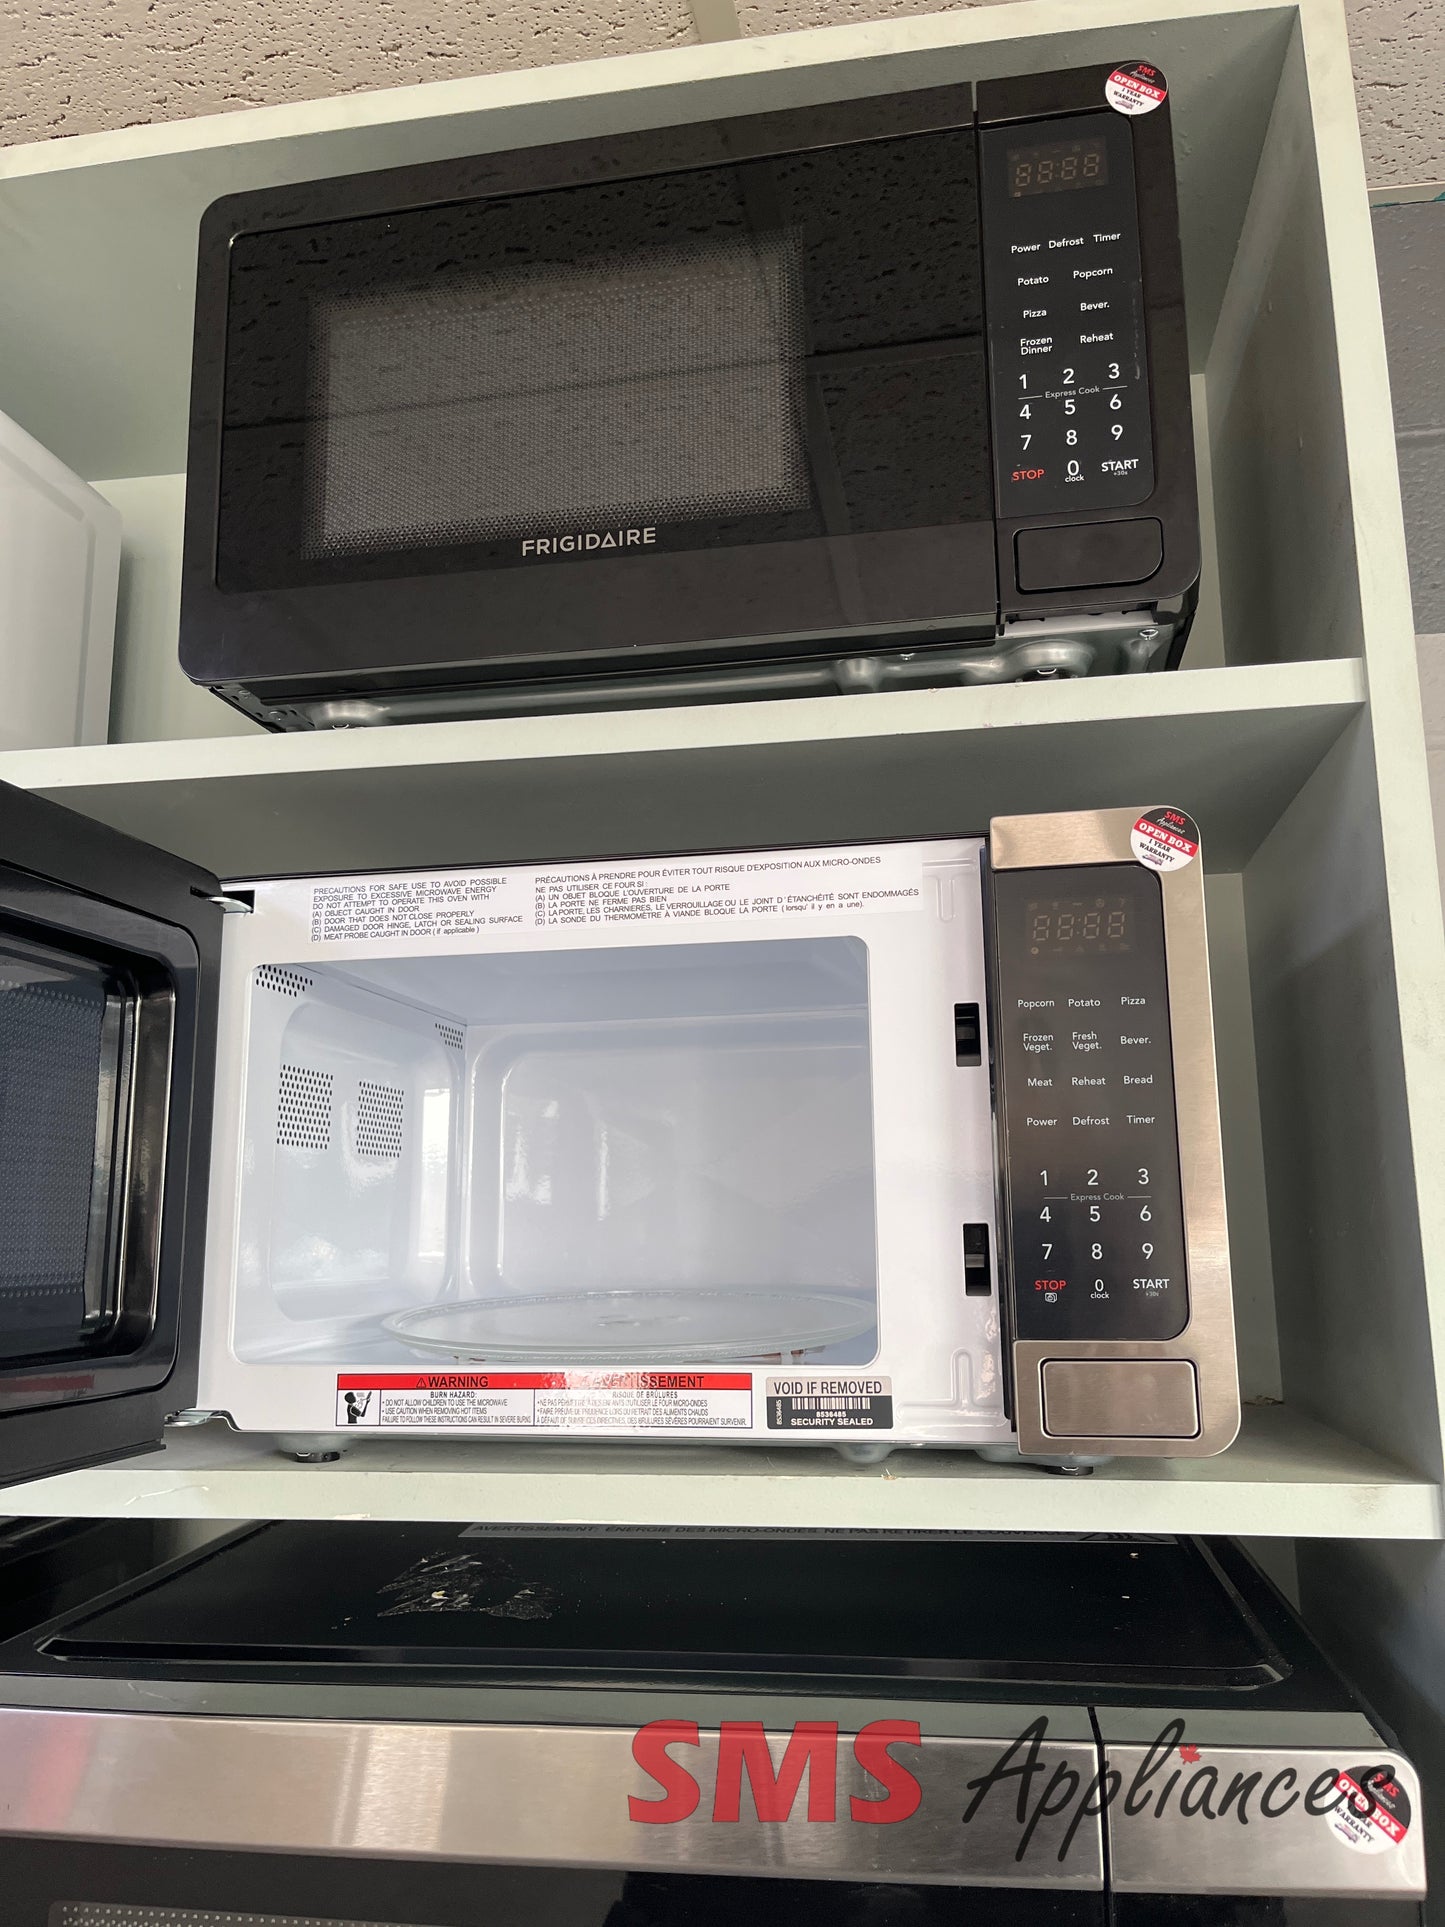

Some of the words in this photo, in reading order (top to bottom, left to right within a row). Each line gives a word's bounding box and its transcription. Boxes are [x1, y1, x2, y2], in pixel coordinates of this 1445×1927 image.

[1138, 65, 1156, 76] SMS
[1114, 75, 1139, 89] OPEN
[1139, 87, 1160, 98] BOX
[1126, 89, 1141, 98] YEAR
[1114, 91, 1144, 106] WARRANTY
[1011, 244, 1040, 253] Power
[1049, 237, 1084, 248] Defrost
[1093, 233, 1121, 242] Timer
[1018, 276, 1049, 286] Potato
[1073, 268, 1113, 280] Popcorn
[1023, 309, 1047, 318] Pizza
[1080, 301, 1110, 311] Bever.
[1021, 337, 1052, 347] Frozen
[1080, 333, 1113, 343] Reheat
[1021, 345, 1052, 355] Dinner
[1019, 374, 1027, 389] 1
[1063, 368, 1074, 384] 2
[1108, 363, 1120, 379] 3
[1045, 390, 1076, 399] Express
[1079, 386, 1100, 394] Cook
[1020, 404, 1031, 419] 4
[1065, 399, 1075, 415] 5
[1110, 394, 1121, 410] 6
[1021, 435, 1031, 450] 7
[1066, 430, 1077, 445] 8
[1111, 425, 1123, 440] 9
[1012, 469, 1045, 481] STOP
[1067, 460, 1079, 475] 0
[1101, 459, 1139, 472] START
[522, 527, 656, 556] FRIGIDAIRE
[1164, 811, 1186, 825] SMS
[1139, 822, 1168, 840] OPEN
[1168, 836, 1192, 852] BOX
[1140, 842, 1175, 862] WARRANTY
[1154, 841, 1171, 852] YEAR
[535, 875, 590, 883] PRÉCAUTIONS
[599, 872, 636, 880] PRENDRE
[638, 870, 660, 878] POUR
[662, 868, 690, 876] ÉVITER
[715, 865, 744, 873] RISQUE
[804, 860, 820, 868] AUX
[822, 856, 881, 867] MICRO-ONDES
[314, 886, 365, 894] PRECAUTIONS
[470, 877, 507, 886] POSSIBLE
[314, 894, 353, 902] EXPOSURE
[371, 891, 412, 899] EXCESSIVE
[416, 888, 461, 896] MICROWAVE
[465, 886, 496, 894] ENERGY
[344, 900, 376, 908] ATTEMPT
[325, 909, 352, 917] OBJECT
[355, 907, 384, 915] CAUGHT
[325, 917, 345, 925] DOOR
[436, 910, 474, 918] PROPERLY
[325, 924, 359, 932] DAMAGED
[415, 920, 437, 928] LATCH
[489, 916, 522, 924] SURFACE
[312, 934, 321, 942] (D)
[370, 930, 399, 938] CAUGHT
[1018, 999, 1055, 1009] Popcorn
[1068, 999, 1100, 1007] Potato
[1121, 997, 1146, 1005] Pizza
[1023, 1033, 1053, 1041] Frozen
[1072, 1031, 1097, 1040] Fresh
[1121, 1036, 1151, 1044] Bever.
[1023, 1043, 1052, 1053] Veget.
[1072, 1041, 1102, 1051] Veget.
[1028, 1078, 1052, 1087] Meat
[1072, 1077, 1106, 1086] Reheat
[1124, 1075, 1153, 1084] Bread
[1027, 1117, 1057, 1126] Power
[1072, 1116, 1110, 1125] Defrost
[1127, 1115, 1155, 1124] Timer
[1040, 1170, 1048, 1186] 1
[1087, 1169, 1098, 1185] 2
[1138, 1168, 1149, 1185] 3
[1071, 1193, 1100, 1202] Express
[1040, 1206, 1051, 1222] 4
[1090, 1206, 1100, 1222] 5
[1140, 1205, 1151, 1221] 6
[1042, 1243, 1052, 1260] 7
[1092, 1243, 1102, 1260] 8
[1142, 1243, 1153, 1260] 9
[1035, 1280, 1066, 1291] STOP
[1095, 1279, 1104, 1292] 0
[1133, 1279, 1169, 1289] START
[1090, 1291, 1110, 1299] clock
[428, 1376, 488, 1387] WARNING
[774, 1382, 802, 1394] VOID
[807, 1382, 817, 1394] IF
[821, 1381, 882, 1394] REMOVED
[791, 1418, 835, 1426] SECURITY
[838, 1418, 873, 1426] SEALED
[1335, 1806, 1375, 1842] WARRANTY
[1372, 1808, 1400, 1836] BOX
